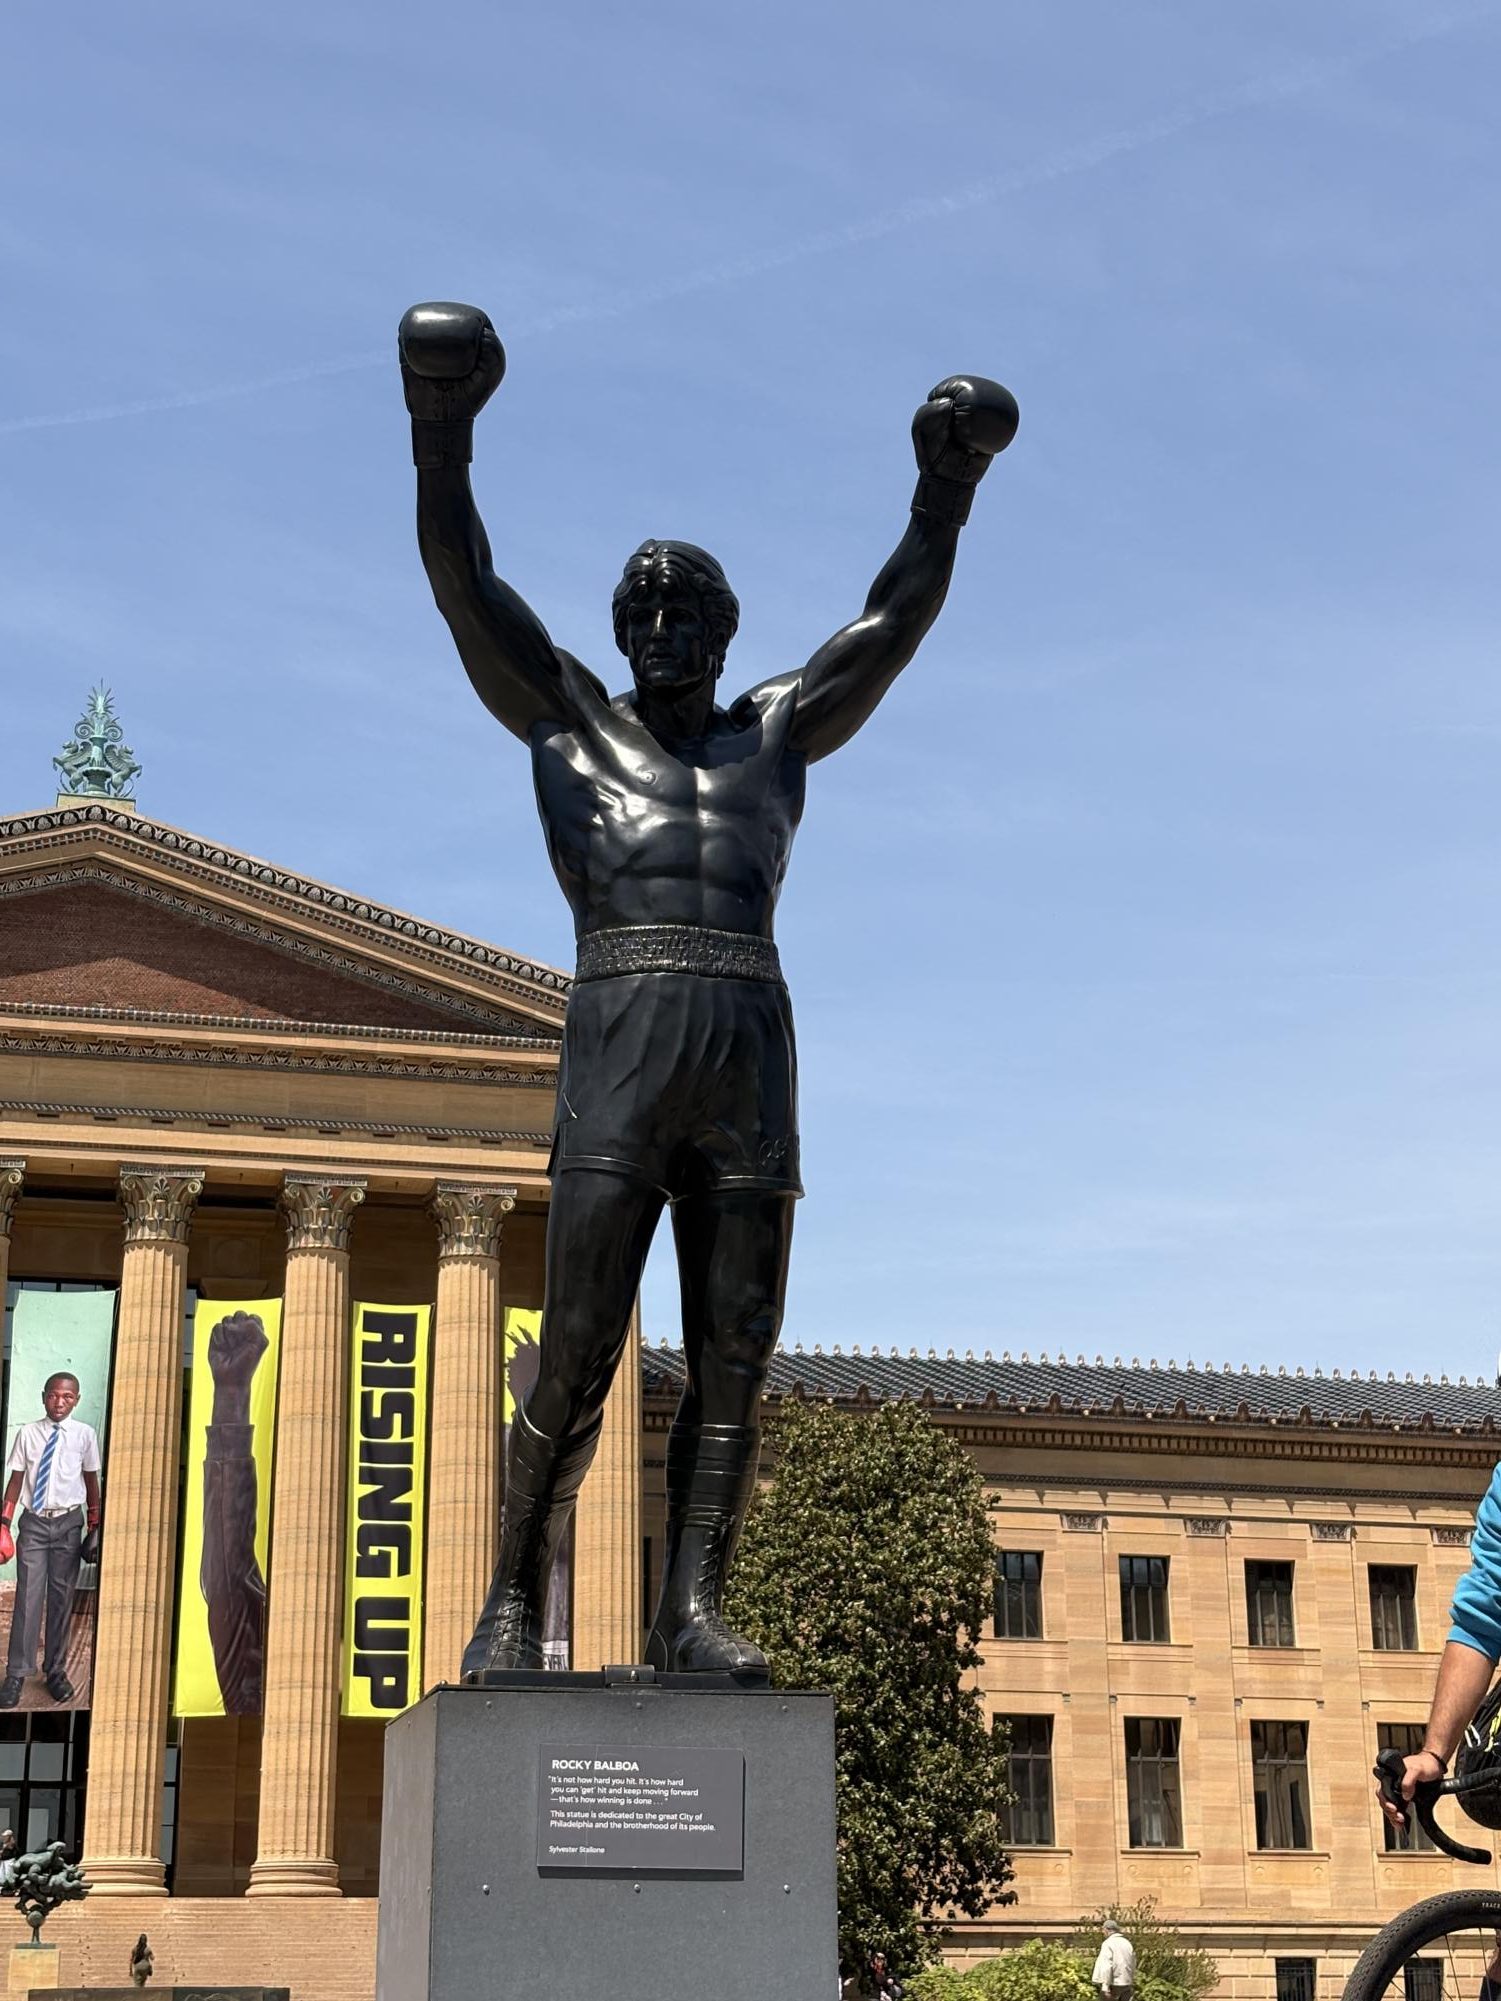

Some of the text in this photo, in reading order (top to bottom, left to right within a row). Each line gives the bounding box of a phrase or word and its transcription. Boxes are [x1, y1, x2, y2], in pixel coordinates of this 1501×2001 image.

[353, 1310, 418, 1709] RISING UP
[552, 1760, 639, 1771] ROCKY BALBOA
[577, 1776, 592, 1784] how
[594, 1776, 611, 1785] hard
[626, 1777, 637, 1785] hit.
[667, 1778, 684, 1786] hard
[551, 1787, 565, 1795] you
[597, 1786, 607, 1794] hit
[608, 1786, 622, 1794] and
[623, 1787, 641, 1796] keep
[642, 1788, 669, 1797] moving
[670, 1787, 699, 1796] forward
[580, 1795, 596, 1804] how
[597, 1796, 625, 1806] winning
[633, 1797, 652, 1805] done
[550, 1810, 565, 1818] This
[590, 1810, 597, 1818] is
[598, 1811, 635, 1819] dedicated
[658, 1813, 678, 1821] great
[679, 1813, 694, 1822] City
[694, 1812, 703, 1820] of
[550, 1820, 716, 1832] Philadelphia and the brotherhood of its people.
[548, 1845, 605, 1854] Sylvester Stallone
